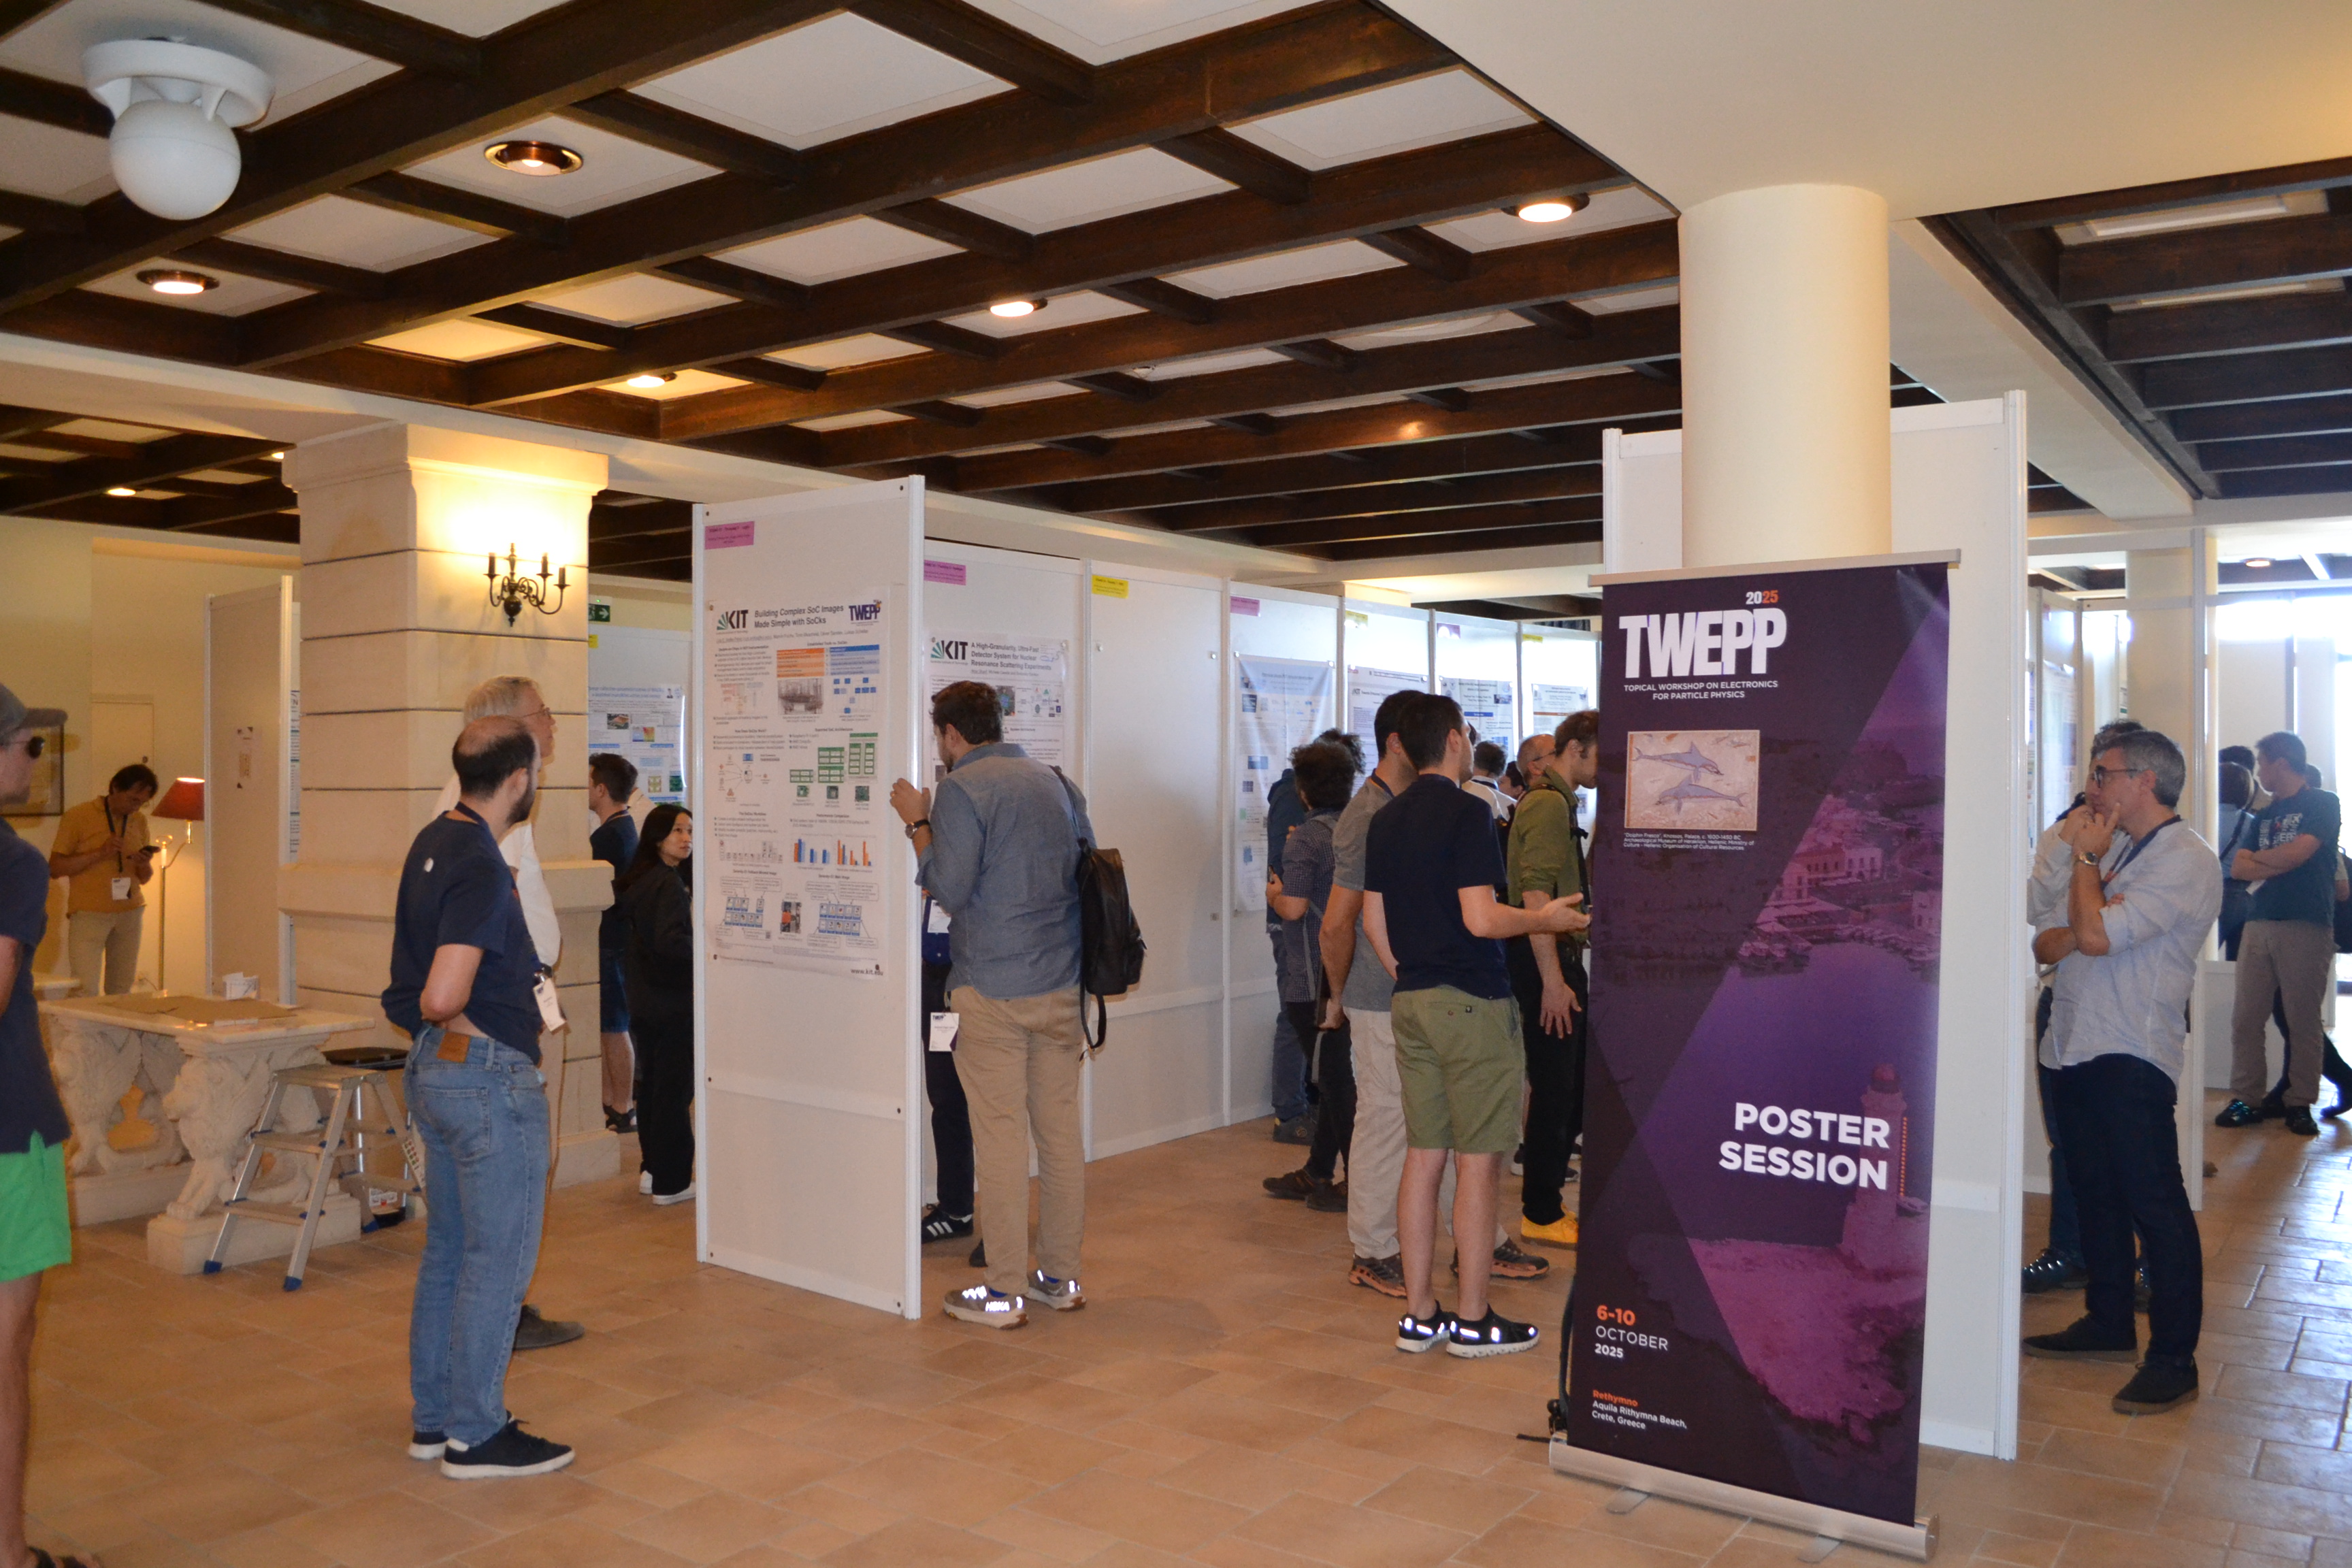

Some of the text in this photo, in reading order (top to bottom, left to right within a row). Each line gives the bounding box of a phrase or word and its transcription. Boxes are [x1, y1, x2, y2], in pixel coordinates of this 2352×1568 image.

[1746, 590, 1779, 604] 2025
[725, 610, 749, 629] KIT
[755, 604, 844, 618] Building Complex SoC Images
[849, 604, 881, 621] TWEPP
[771, 619, 791, 628] Simple
[792, 617, 805, 625] with
[806, 617, 826, 625] SoCks
[941, 640, 968, 660] KIT
[1619, 608, 1787, 679] TWEPP
[1000, 661, 1024, 670] Scattering
[1624, 684, 1656, 692] TOPICAL
[1659, 682, 1705, 691] WORKSHOP
[1720, 681, 1778, 689] ELECTRONICS
[1734, 1102, 1890, 1149] POSTER
[1718, 1141, 1888, 1190] SESSION
[1597, 1305, 1635, 1326] 6-10
[1596, 1325, 1668, 1351] OCTOBER
[1595, 1343, 1624, 1358] 2025
[1592, 1389, 1638, 1407] Rethymno
[1592, 1400, 1687, 1429] Aquila Rithymna Beach,
[1592, 1410, 1646, 1430] Crete, Greece
